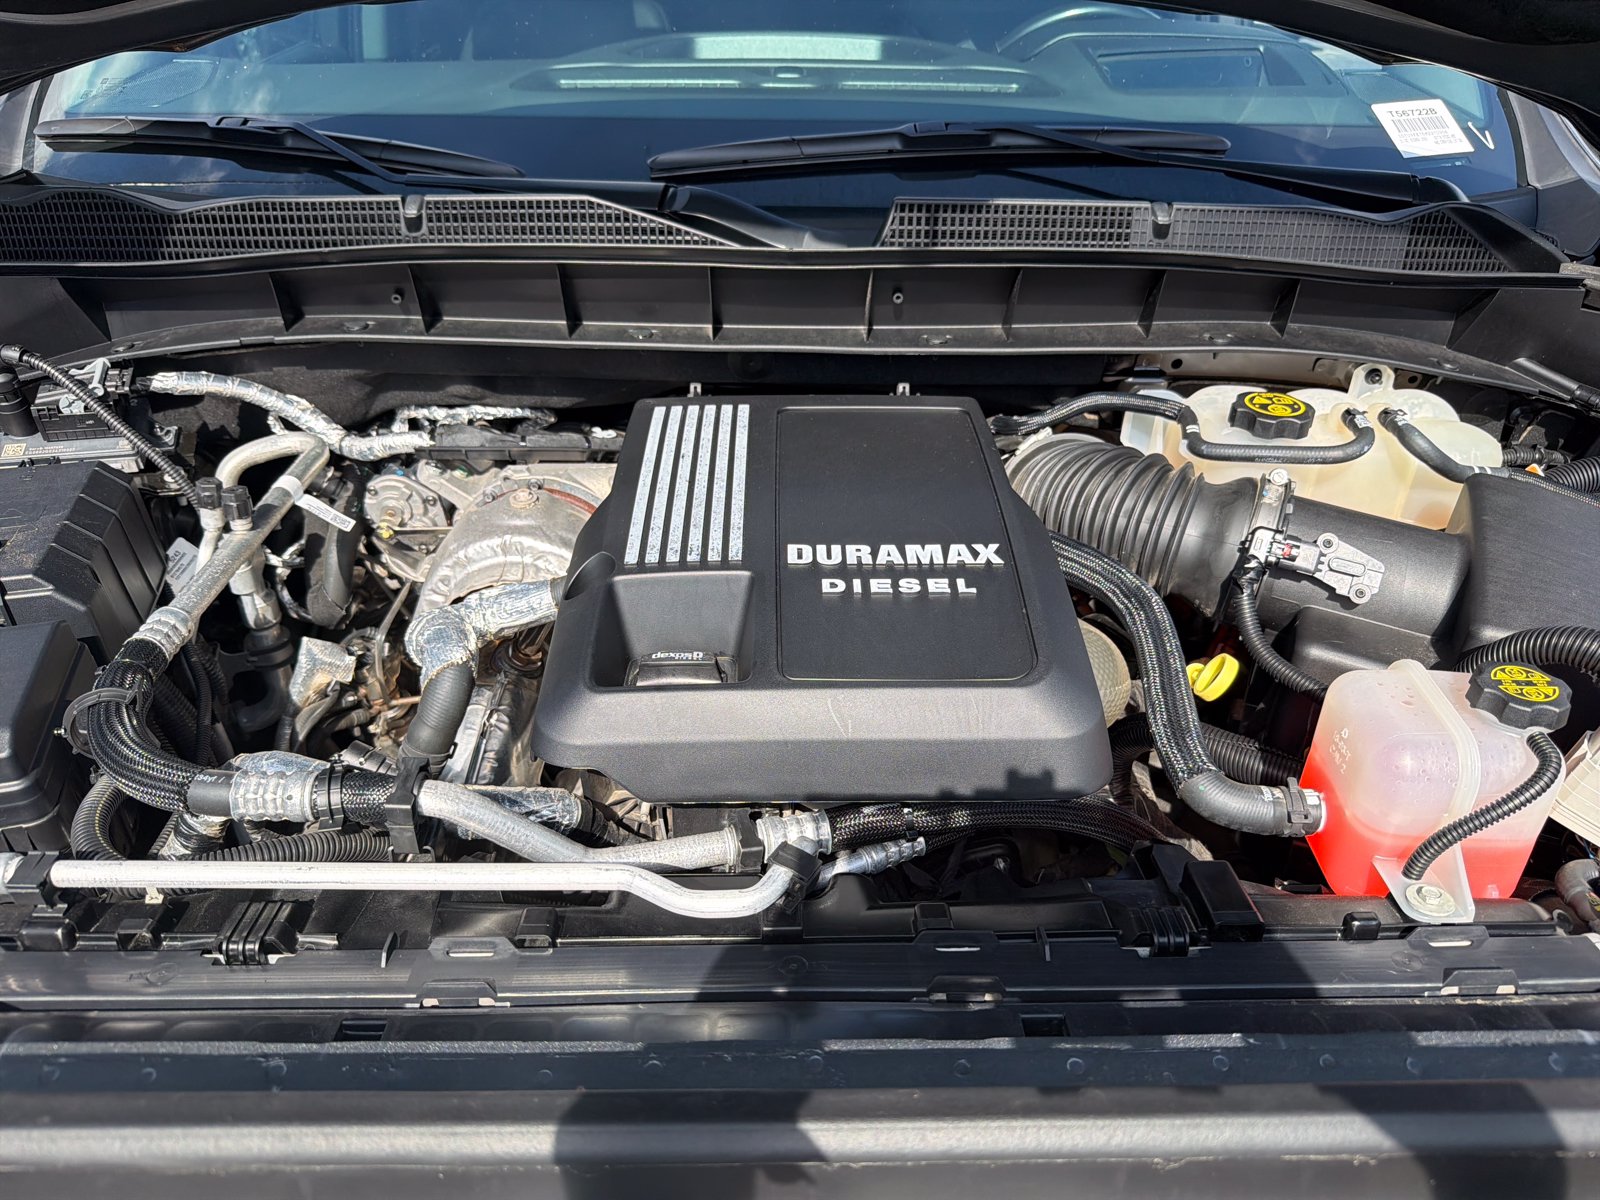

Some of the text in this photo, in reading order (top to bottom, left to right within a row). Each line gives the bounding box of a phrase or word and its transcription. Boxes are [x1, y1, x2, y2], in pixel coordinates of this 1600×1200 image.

[1387, 107, 1437, 117] T56722B
[787, 543, 1004, 565] DURAMAX
[821, 578, 977, 594] DIESEL
